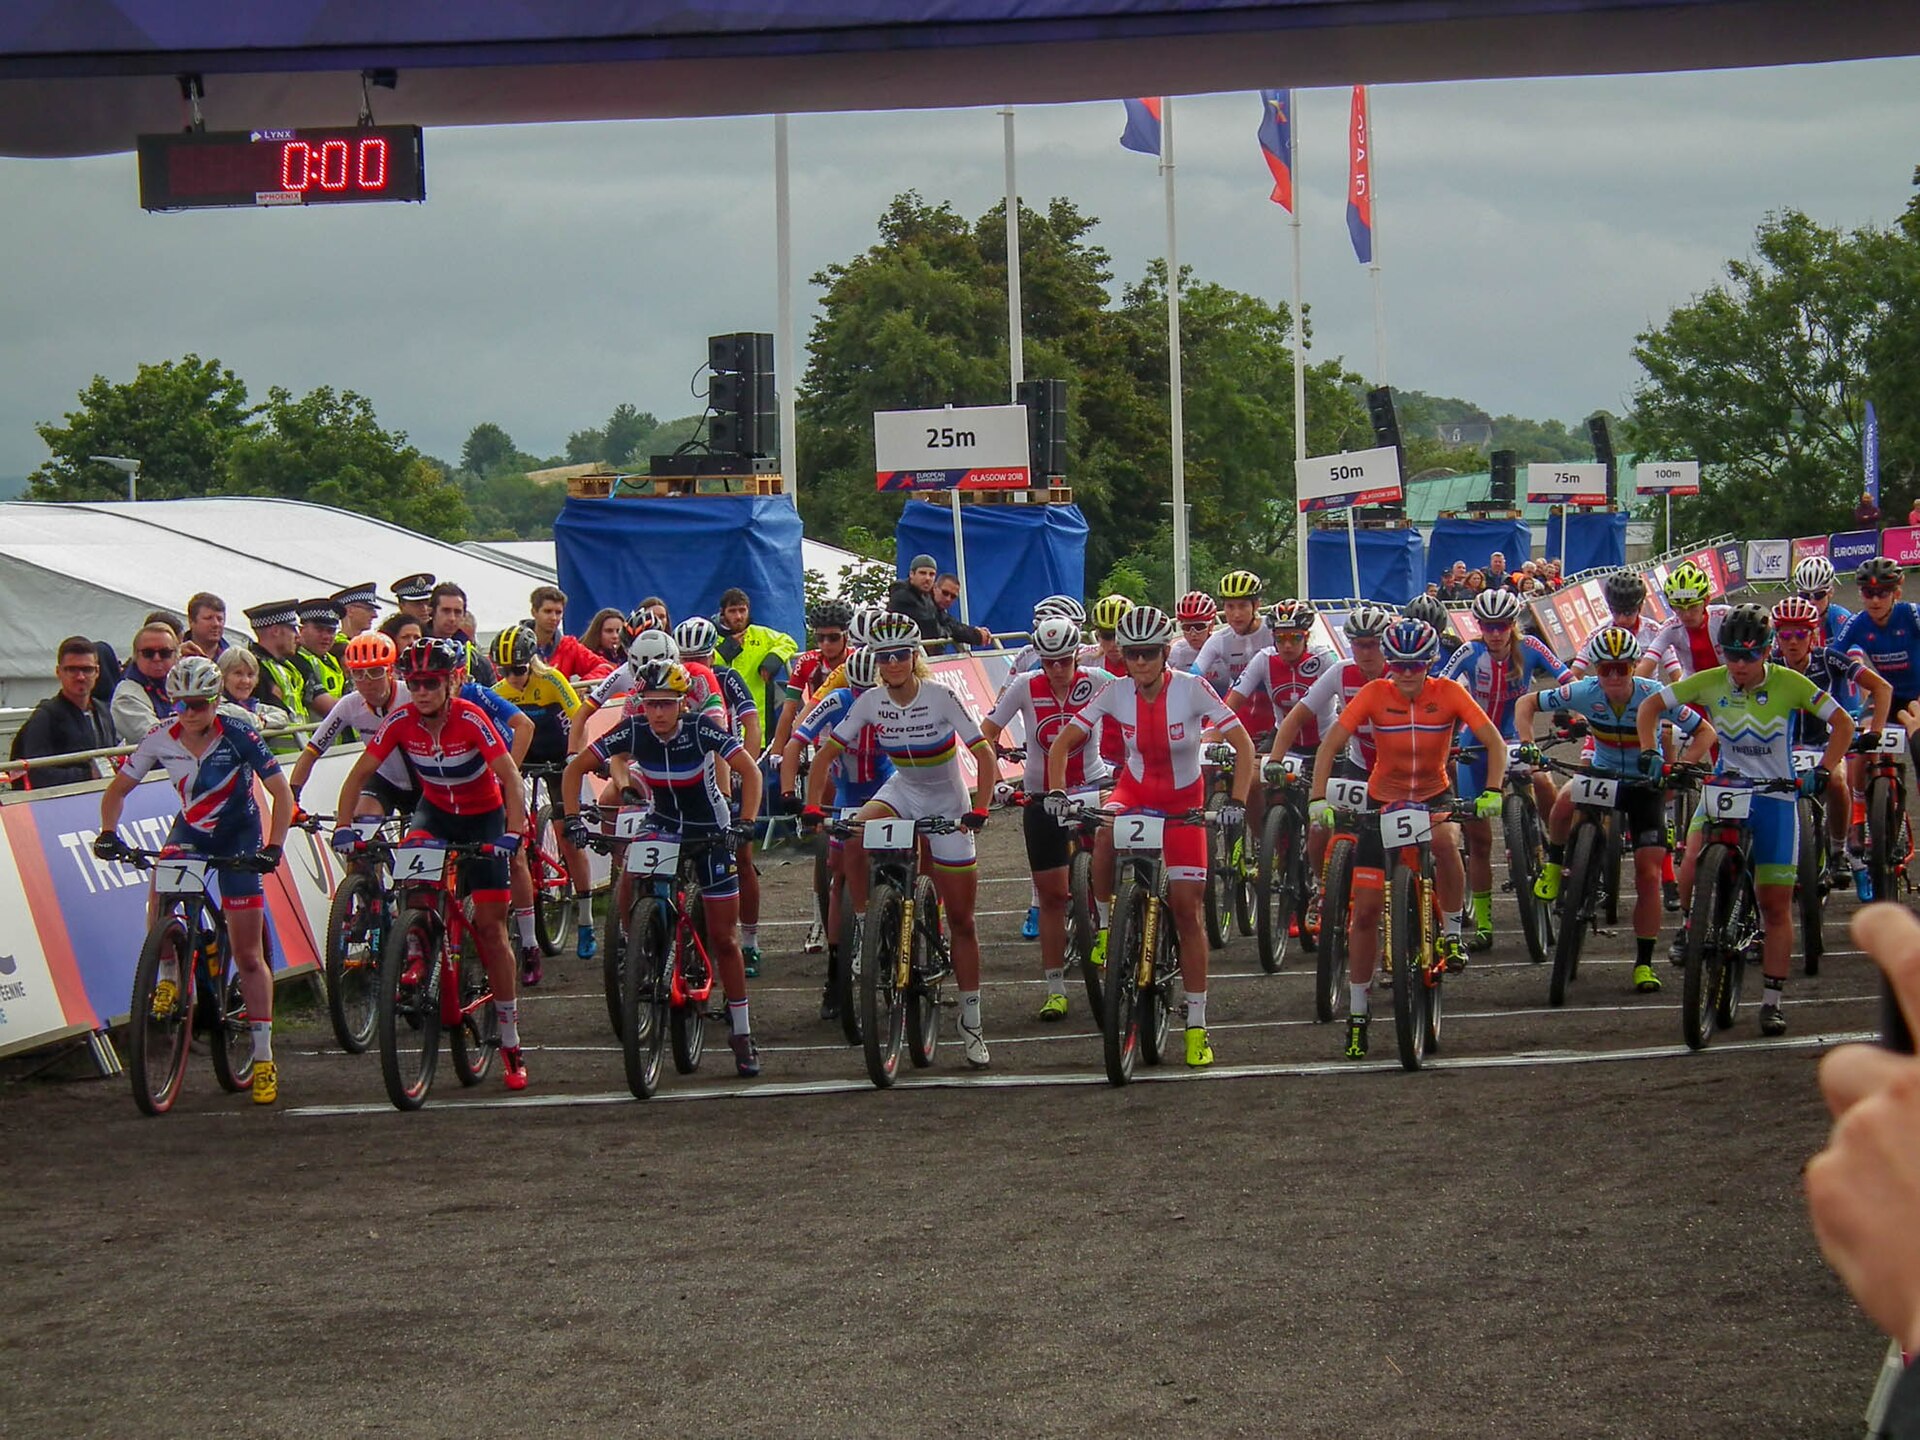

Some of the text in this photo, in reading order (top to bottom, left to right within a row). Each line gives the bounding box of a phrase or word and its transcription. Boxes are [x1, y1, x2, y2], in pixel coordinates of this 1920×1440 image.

[265, 131, 293, 140] LYNX
[282, 140, 386, 190] 0:00
[264, 193, 301, 201] PHOENIX
[927, 428, 976, 448] 25m
[970, 473, 1023, 482] GLASGOW 2018
[1330, 466, 1364, 481] 50m
[1554, 473, 1580, 483] 75m
[1655, 469, 1681, 479] 100m
[1834, 544, 1875, 557] EUROVISION
[1766, 555, 1781, 568] UEC
[1525, 637, 1561, 669] STRABAG
[728, 677, 747, 700] SKF
[226, 717, 250, 732] HSBC
[882, 711, 898, 720] UCI
[604, 727, 631, 746] SKF
[699, 726, 728, 742] SKF
[886, 723, 934, 733] KROSS
[1792, 755, 1815, 768] 21
[1336, 783, 1364, 805] 16
[1581, 779, 1609, 800] 14
[1717, 792, 1733, 811] 6
[881, 824, 894, 842] 1
[1130, 820, 1145, 842] 2
[1396, 816, 1413, 838] 5
[409, 854, 424, 873] 4
[644, 847, 660, 868] 3
[174, 866, 188, 885] 7
